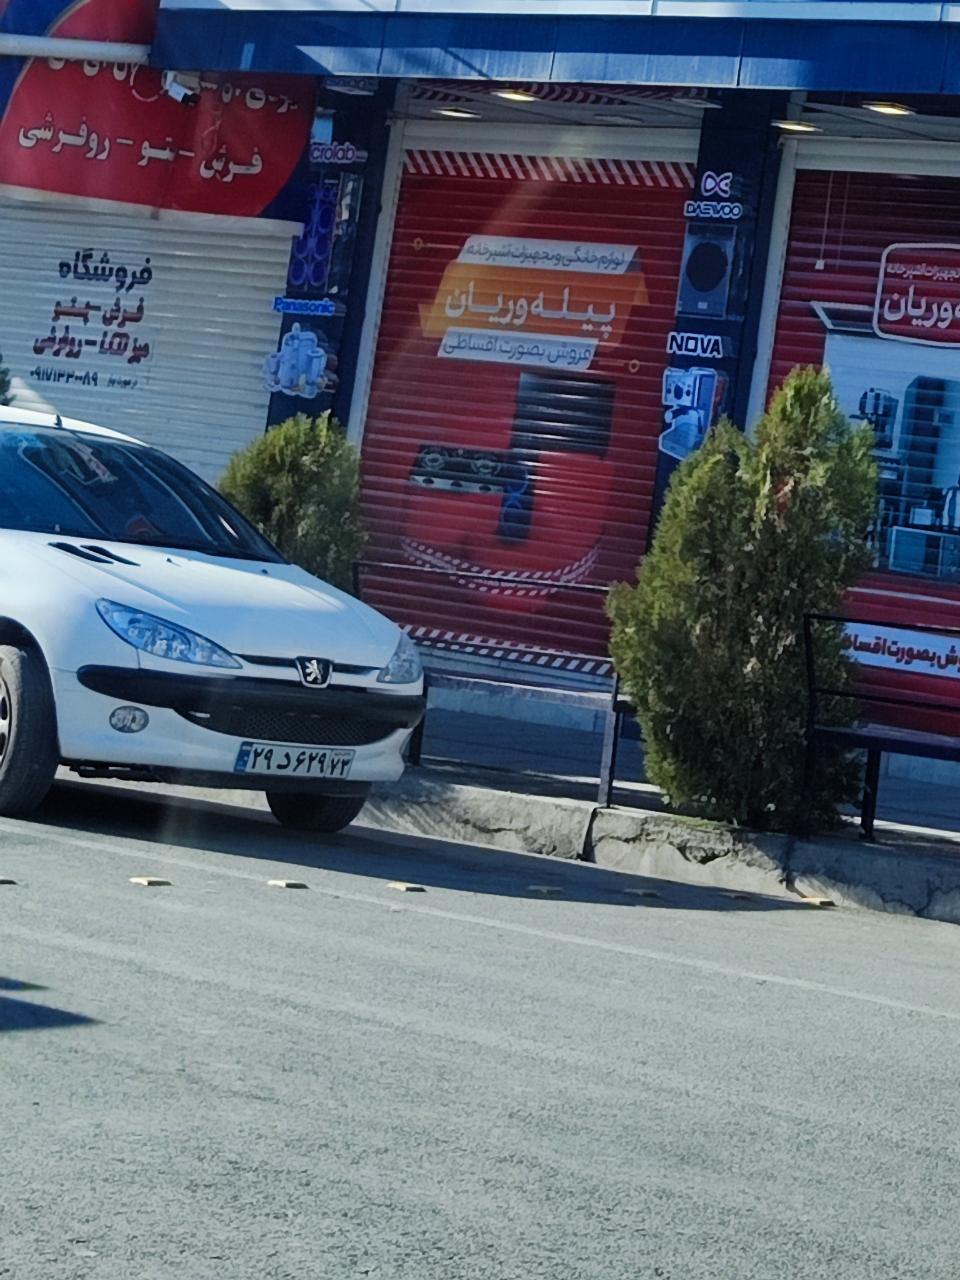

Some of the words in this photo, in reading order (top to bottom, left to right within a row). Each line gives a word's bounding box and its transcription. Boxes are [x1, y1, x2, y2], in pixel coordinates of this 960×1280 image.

[18, 112, 111, 160] روفرشی
[200, 146, 263, 182] فرش
[685, 201, 742, 219] DAEWOO
[59, 247, 153, 294] فروشگاه
[274, 296, 335, 316] Panasonic
[547, 344, 594, 363] فروش
[667, 332, 722, 358] NOVA
[887, 640, 936, 667] بصورت
